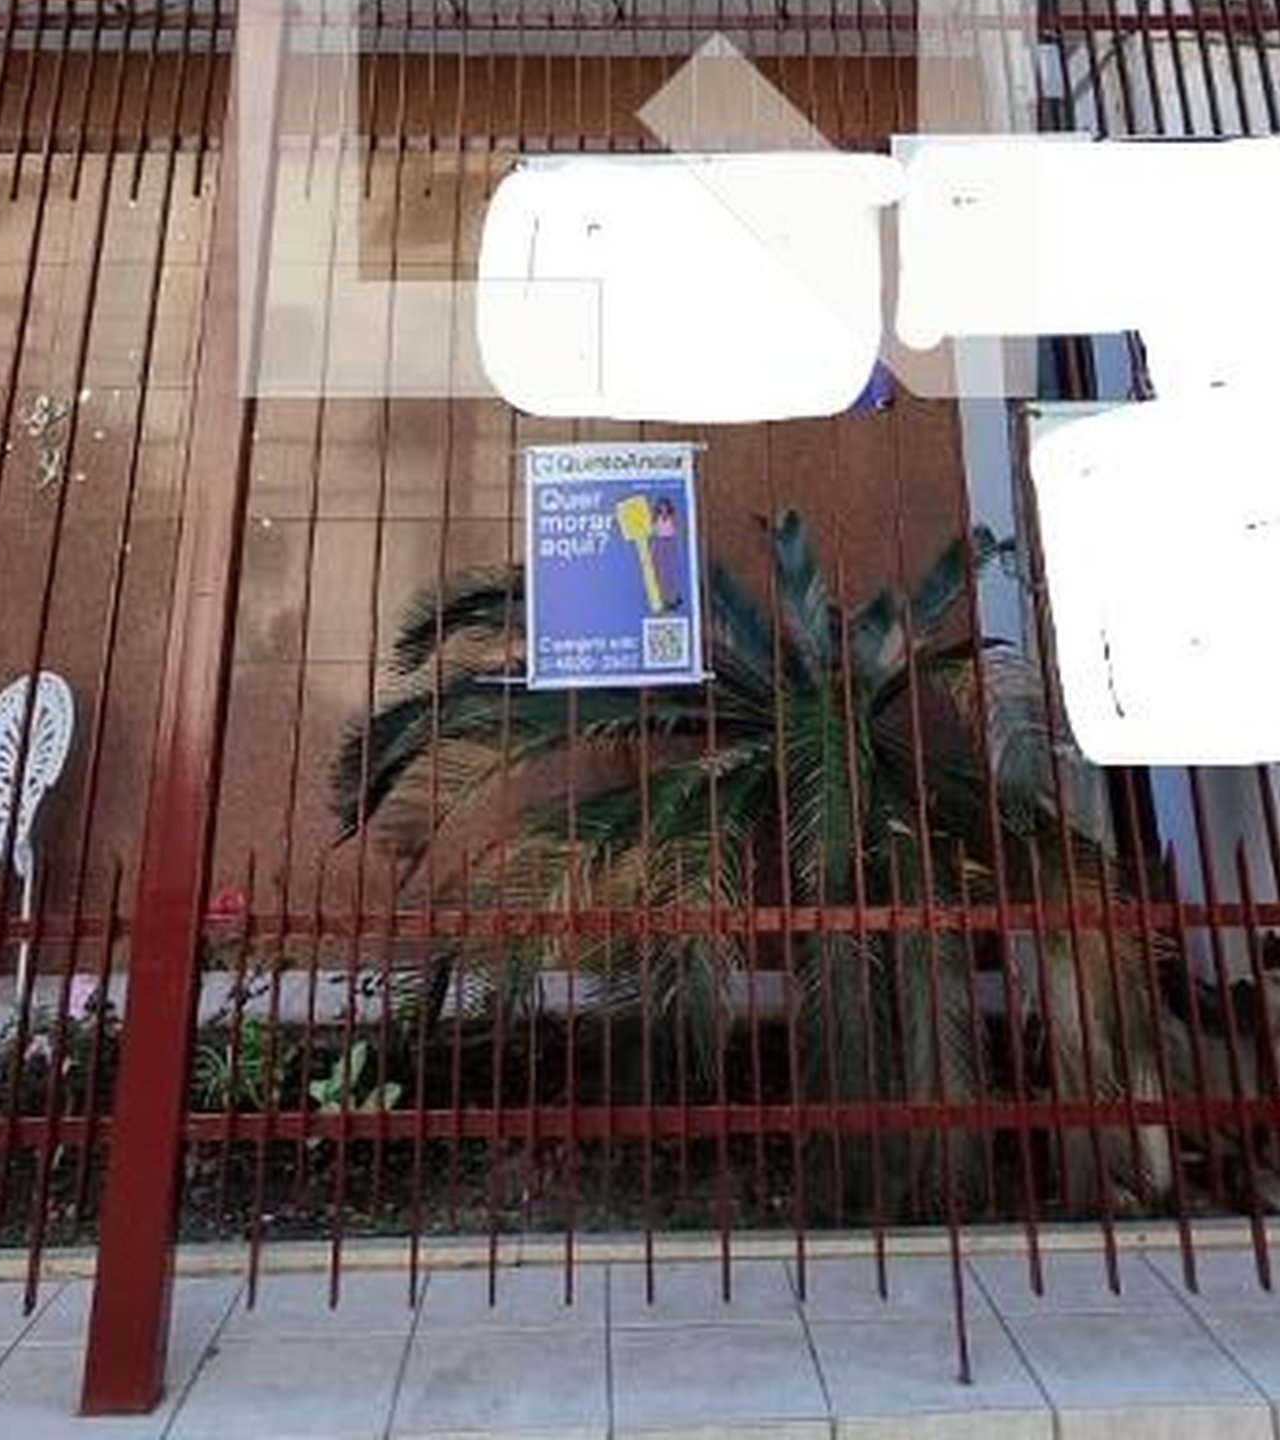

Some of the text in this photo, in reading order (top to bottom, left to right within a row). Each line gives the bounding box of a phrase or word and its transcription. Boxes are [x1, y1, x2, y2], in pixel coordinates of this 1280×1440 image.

[539, 488, 602, 511] Quer
[539, 514, 613, 532] morar
[539, 533, 609, 558] aqui?
